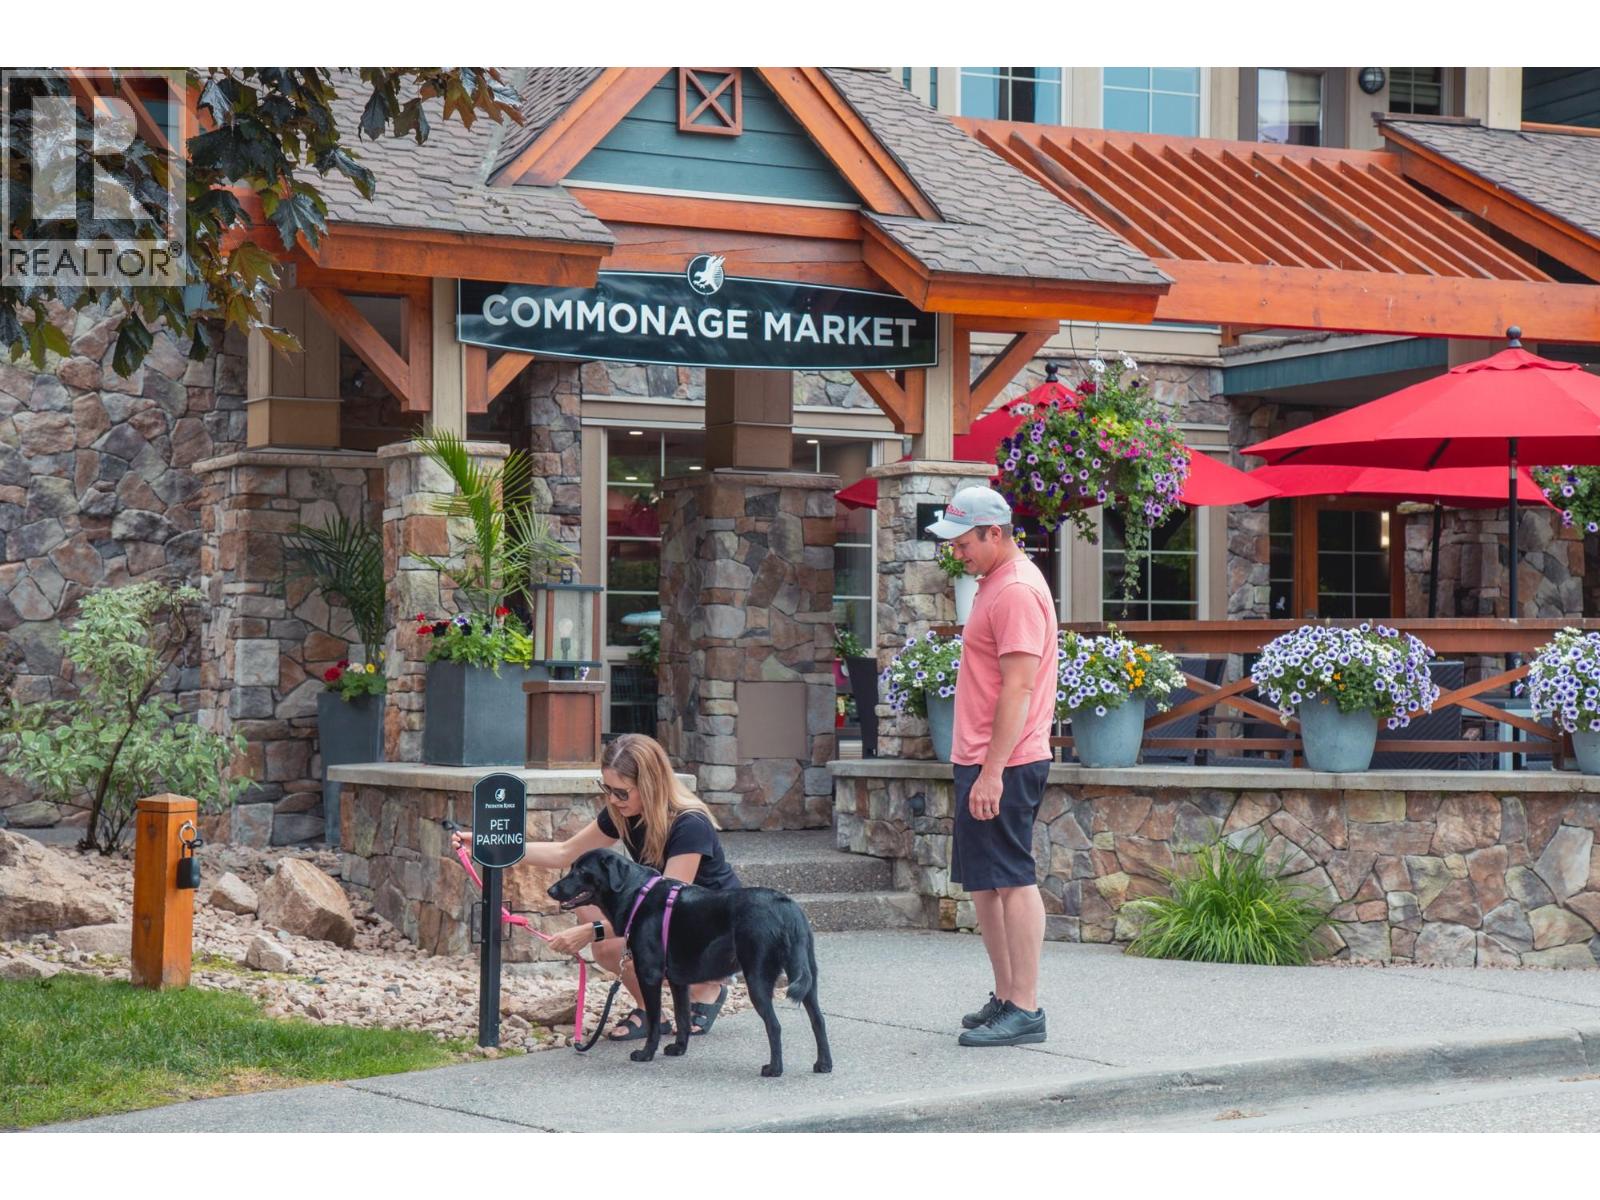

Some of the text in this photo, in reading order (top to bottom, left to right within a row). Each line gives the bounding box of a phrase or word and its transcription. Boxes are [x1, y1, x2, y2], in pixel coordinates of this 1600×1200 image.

[481, 293, 917, 349] COMMONAGE MARKET
[490, 819, 510, 830] PET
[476, 833, 523, 845] PARKING
